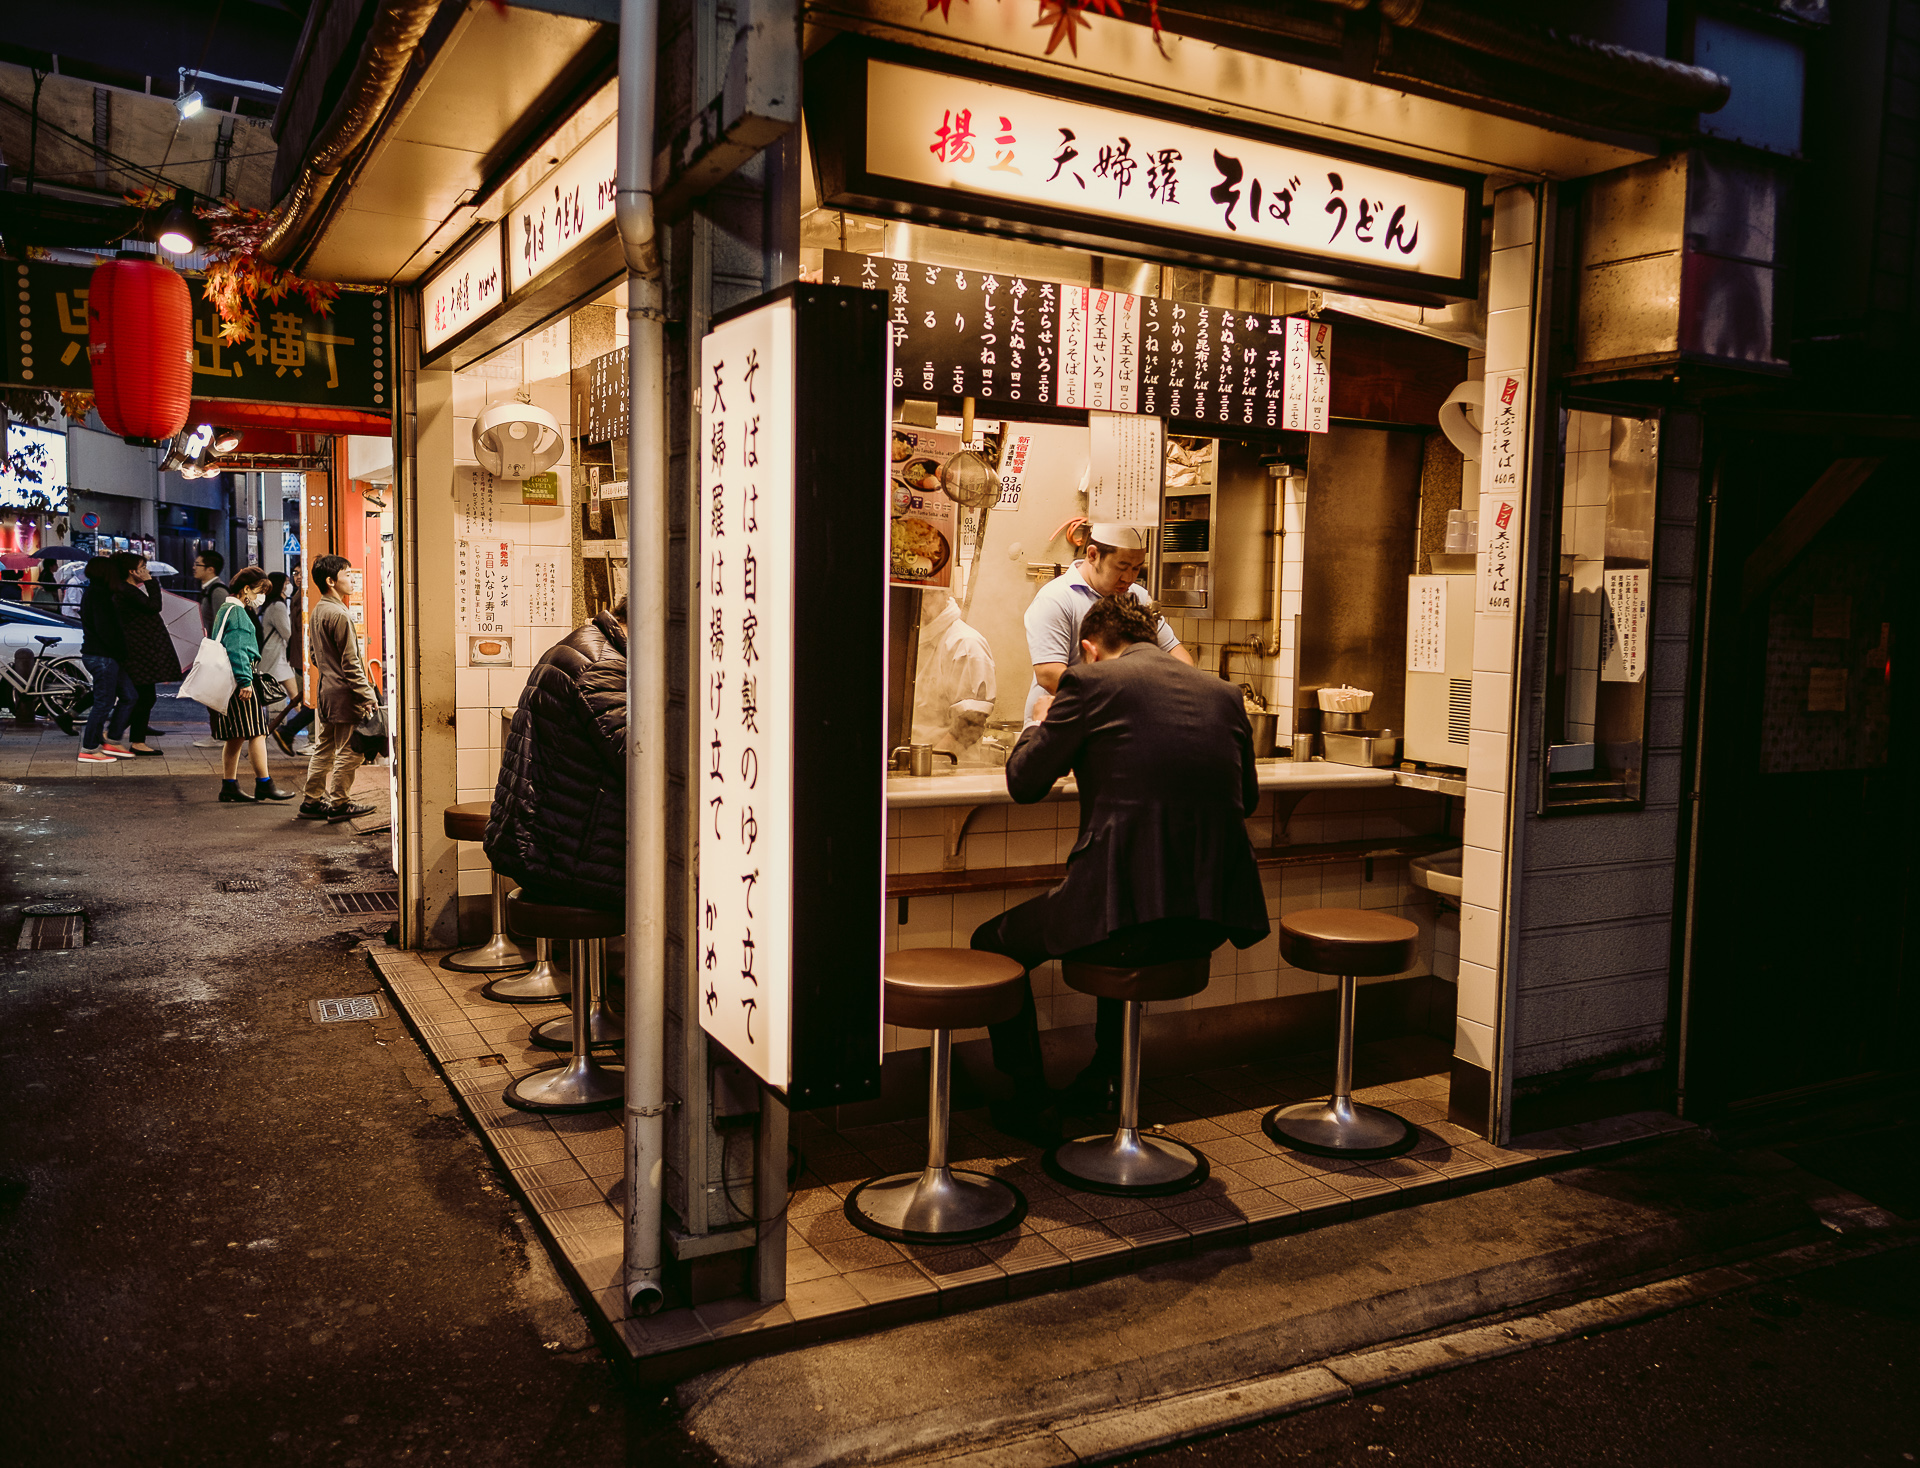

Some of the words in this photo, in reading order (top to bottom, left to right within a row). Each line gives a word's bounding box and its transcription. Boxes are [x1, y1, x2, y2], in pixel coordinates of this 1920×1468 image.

[1046, 127, 1183, 206] 天婦羅
[1210, 148, 1302, 233] そば
[1325, 171, 1420, 255] うどん
[523, 206, 546, 277] そば
[554, 184, 585, 248] うどん
[890, 262, 911, 347] 温泉玉子
[923, 266, 942, 329] ざる
[954, 270, 968, 333] もり
[980, 274, 1000, 364] 冷しきつね
[1010, 278, 1028, 369] 冷したぬき
[1145, 298, 1160, 352] きつね
[1037, 283, 1056, 373] 天ぷらせいろ
[1092, 313, 1108, 379] 天玉せいろ
[1171, 303, 1186, 355] わかめ
[1194, 307, 1211, 363] とろろ昆布
[1220, 310, 1235, 363] たぬき
[1243, 315, 1259, 365] かけ
[1266, 318, 1283, 369] 玉子
[1291, 322, 1304, 370] 天ぷら
[1313, 345, 1327, 376] 天玉
[1497, 406, 1516, 468] 天ぷらそば
[1002, 476, 1018, 484] 03
[1494, 472, 1516, 484] 460円
[499, 542, 509, 567] 新発売
[1492, 531, 1510, 592] 天ぷらそば
[485, 551, 496, 623] 五目いなり寿司
[1489, 597, 1510, 608] 460円
